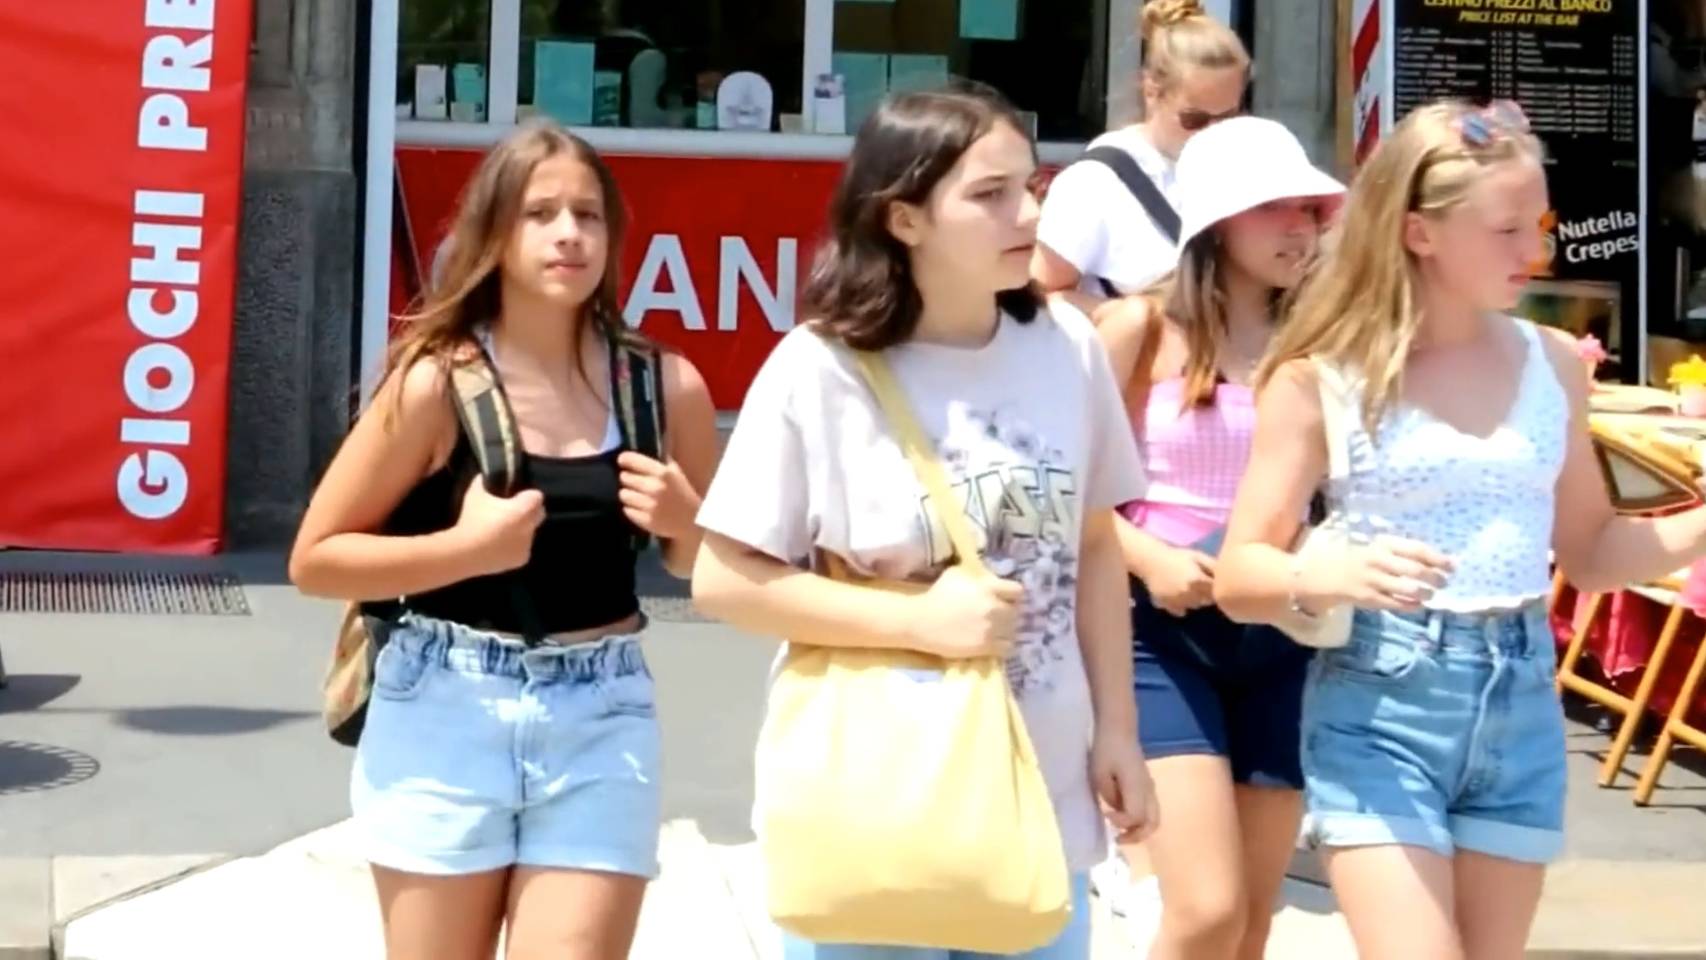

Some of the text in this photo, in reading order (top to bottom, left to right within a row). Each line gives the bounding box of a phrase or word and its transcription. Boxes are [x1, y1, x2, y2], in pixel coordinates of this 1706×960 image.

[1556, 210, 1637, 242] Nutella
[1566, 234, 1639, 264] Crepes
[117, 190, 204, 520] GIOCHI
